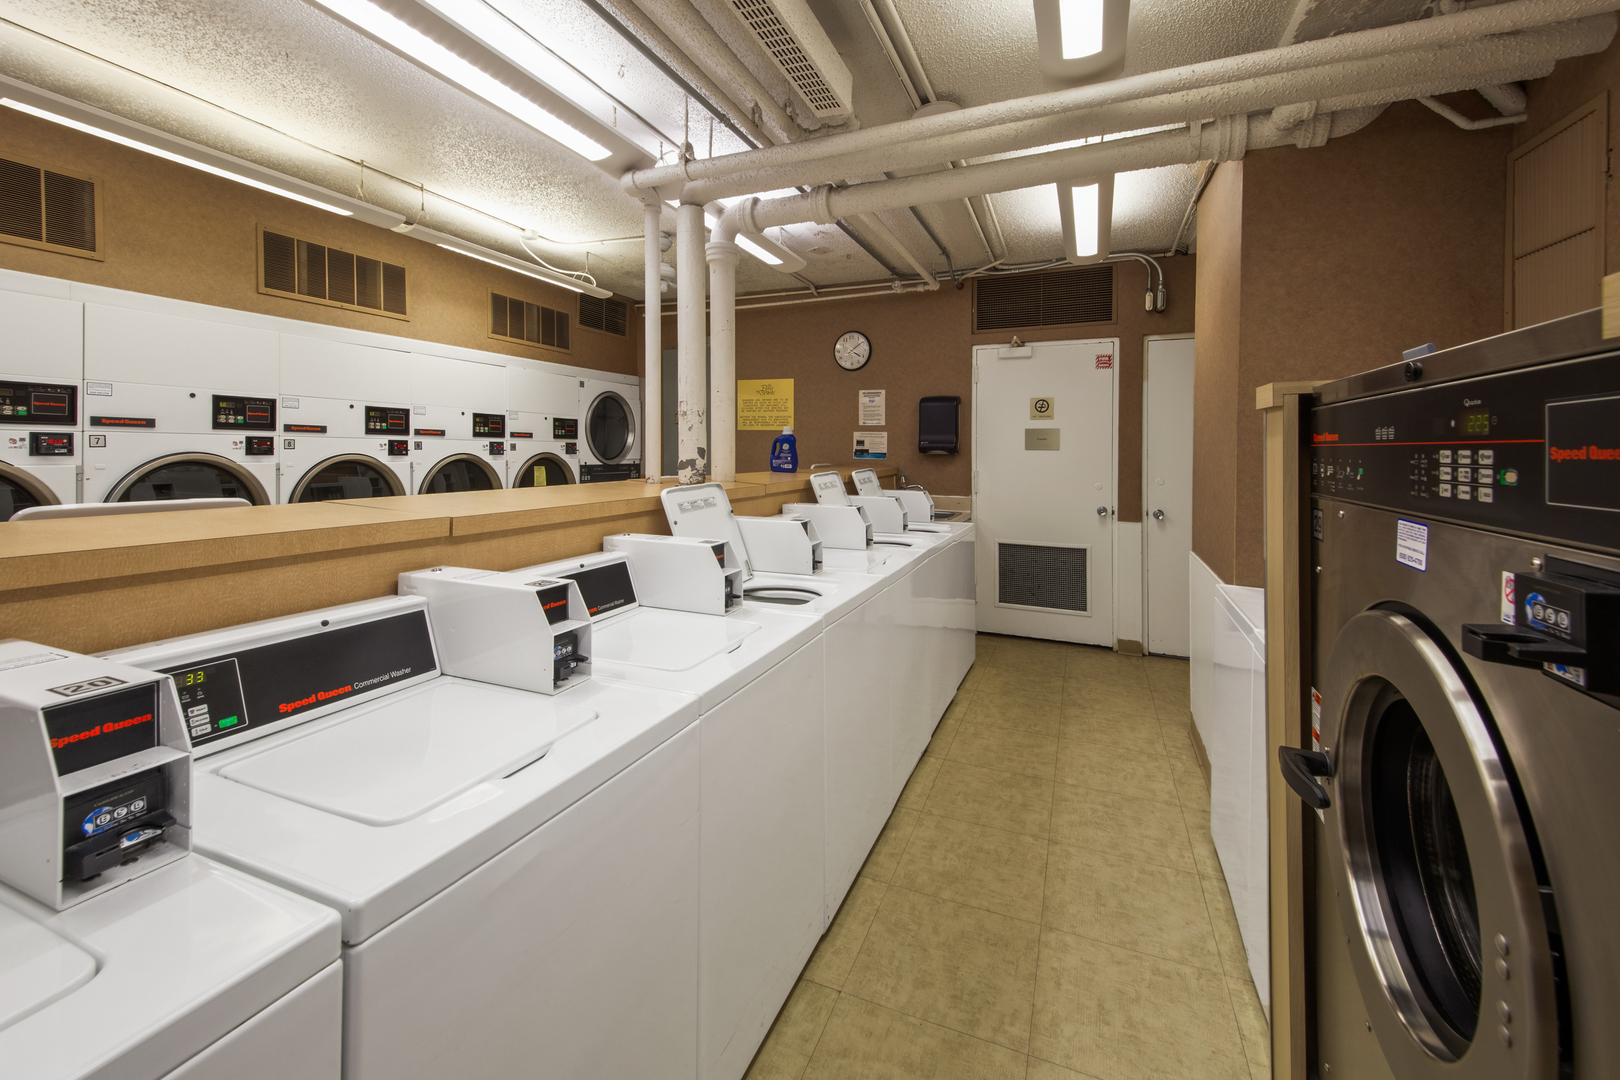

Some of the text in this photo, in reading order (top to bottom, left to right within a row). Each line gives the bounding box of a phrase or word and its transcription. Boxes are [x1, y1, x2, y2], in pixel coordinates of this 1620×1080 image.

[95, 437, 100, 445] 7
[1550, 446, 1587, 462] Speed
[187, 671, 204, 686] 33
[63, 680, 111, 697] 20
[279, 666, 412, 713] Speed Queen Commercial Washer
[50, 714, 153, 749] Speed Queen
